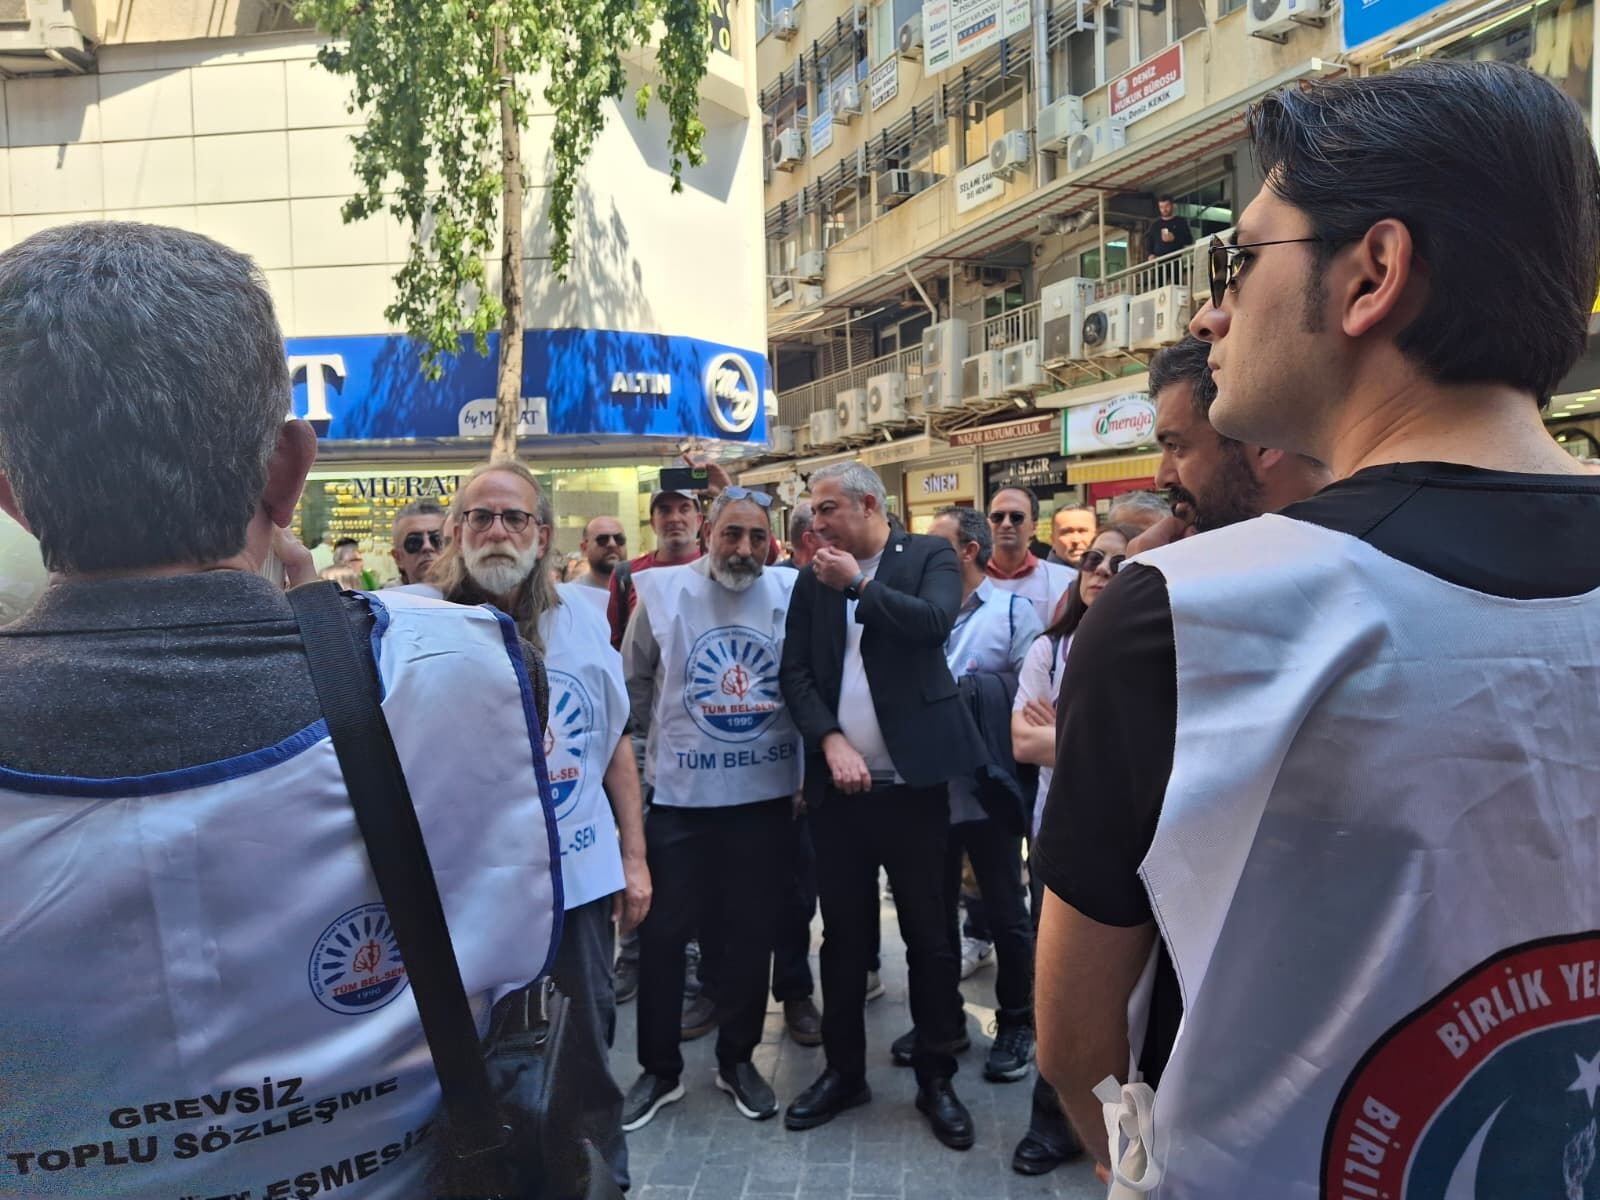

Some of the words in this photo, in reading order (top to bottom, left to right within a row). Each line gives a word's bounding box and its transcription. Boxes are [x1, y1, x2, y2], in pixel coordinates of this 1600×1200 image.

[1132, 66, 1156, 87] DENİZ
[1114, 90, 1143, 112] HUKUK
[1143, 69, 1177, 97] BÜROSU
[285, 353, 346, 421] T
[611, 372, 672, 394] ALTIN
[464, 410, 478, 428] by
[480, 410, 539, 425] MAT
[957, 432, 983, 445] NAZAR
[983, 422, 1041, 442] KUYUMCULUK
[922, 474, 958, 495] SİNEM
[676, 749, 717, 769] TÜM
[550, 768, 580, 781] L-SEN
[333, 981, 358, 996] TÜM
[361, 966, 406, 988] BEL-SEN
[1435, 967, 1552, 1059] BİRLİK
[1559, 960, 1600, 1001] YE
[109, 1076, 305, 1129] GREVSİZ
[7, 1135, 158, 1175] TOPLU
[172, 1076, 400, 1160] SÖZLEŞME
[1342, 1095, 1401, 1200] BİRLİ
